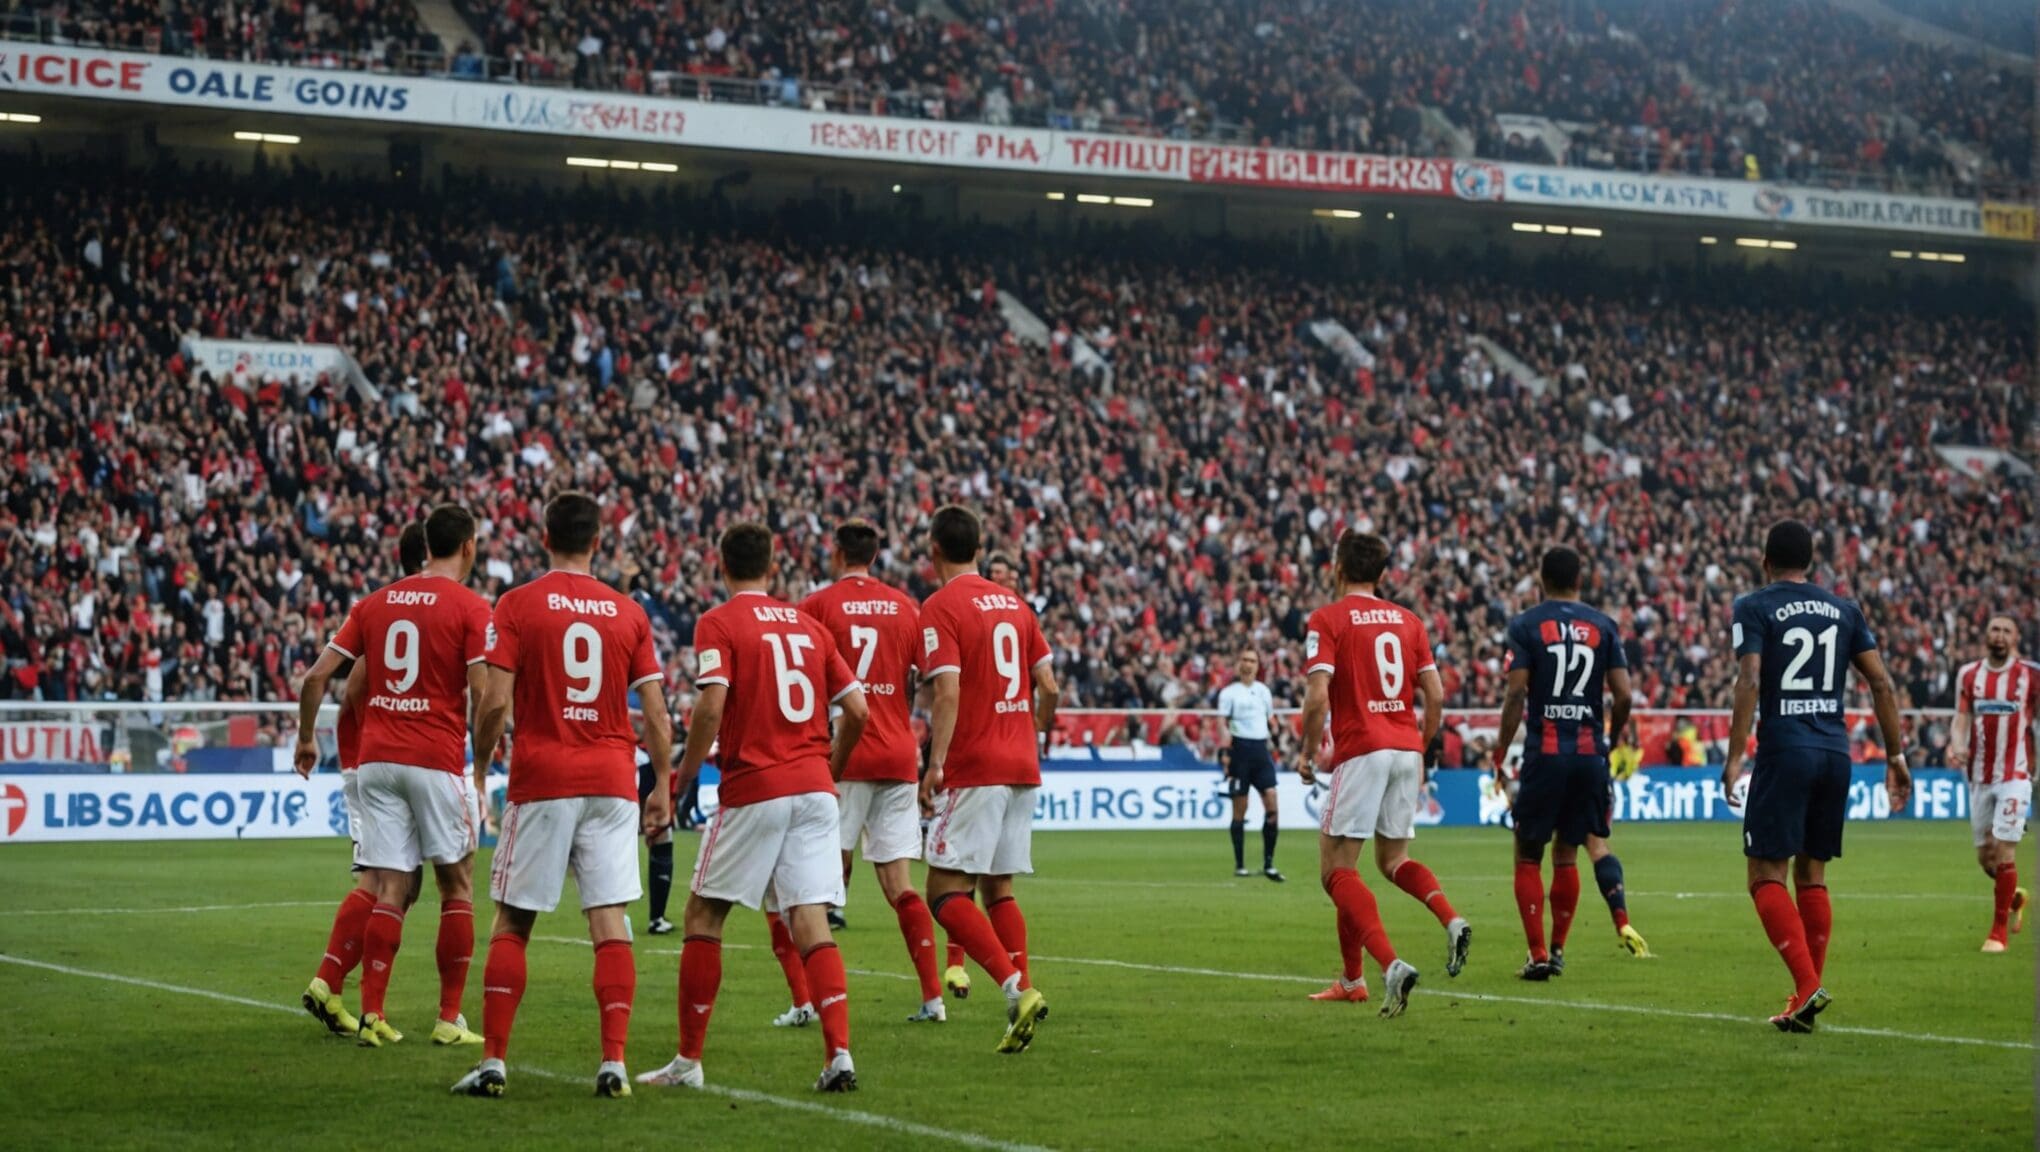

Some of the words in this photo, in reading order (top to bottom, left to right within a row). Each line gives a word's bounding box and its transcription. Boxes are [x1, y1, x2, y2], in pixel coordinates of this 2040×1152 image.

[384, 619, 420, 695] 9
[563, 621, 603, 703] 9
[850, 625, 878, 680] 7
[992, 622, 1020, 700] 9
[1780, 624, 1838, 692] 21
